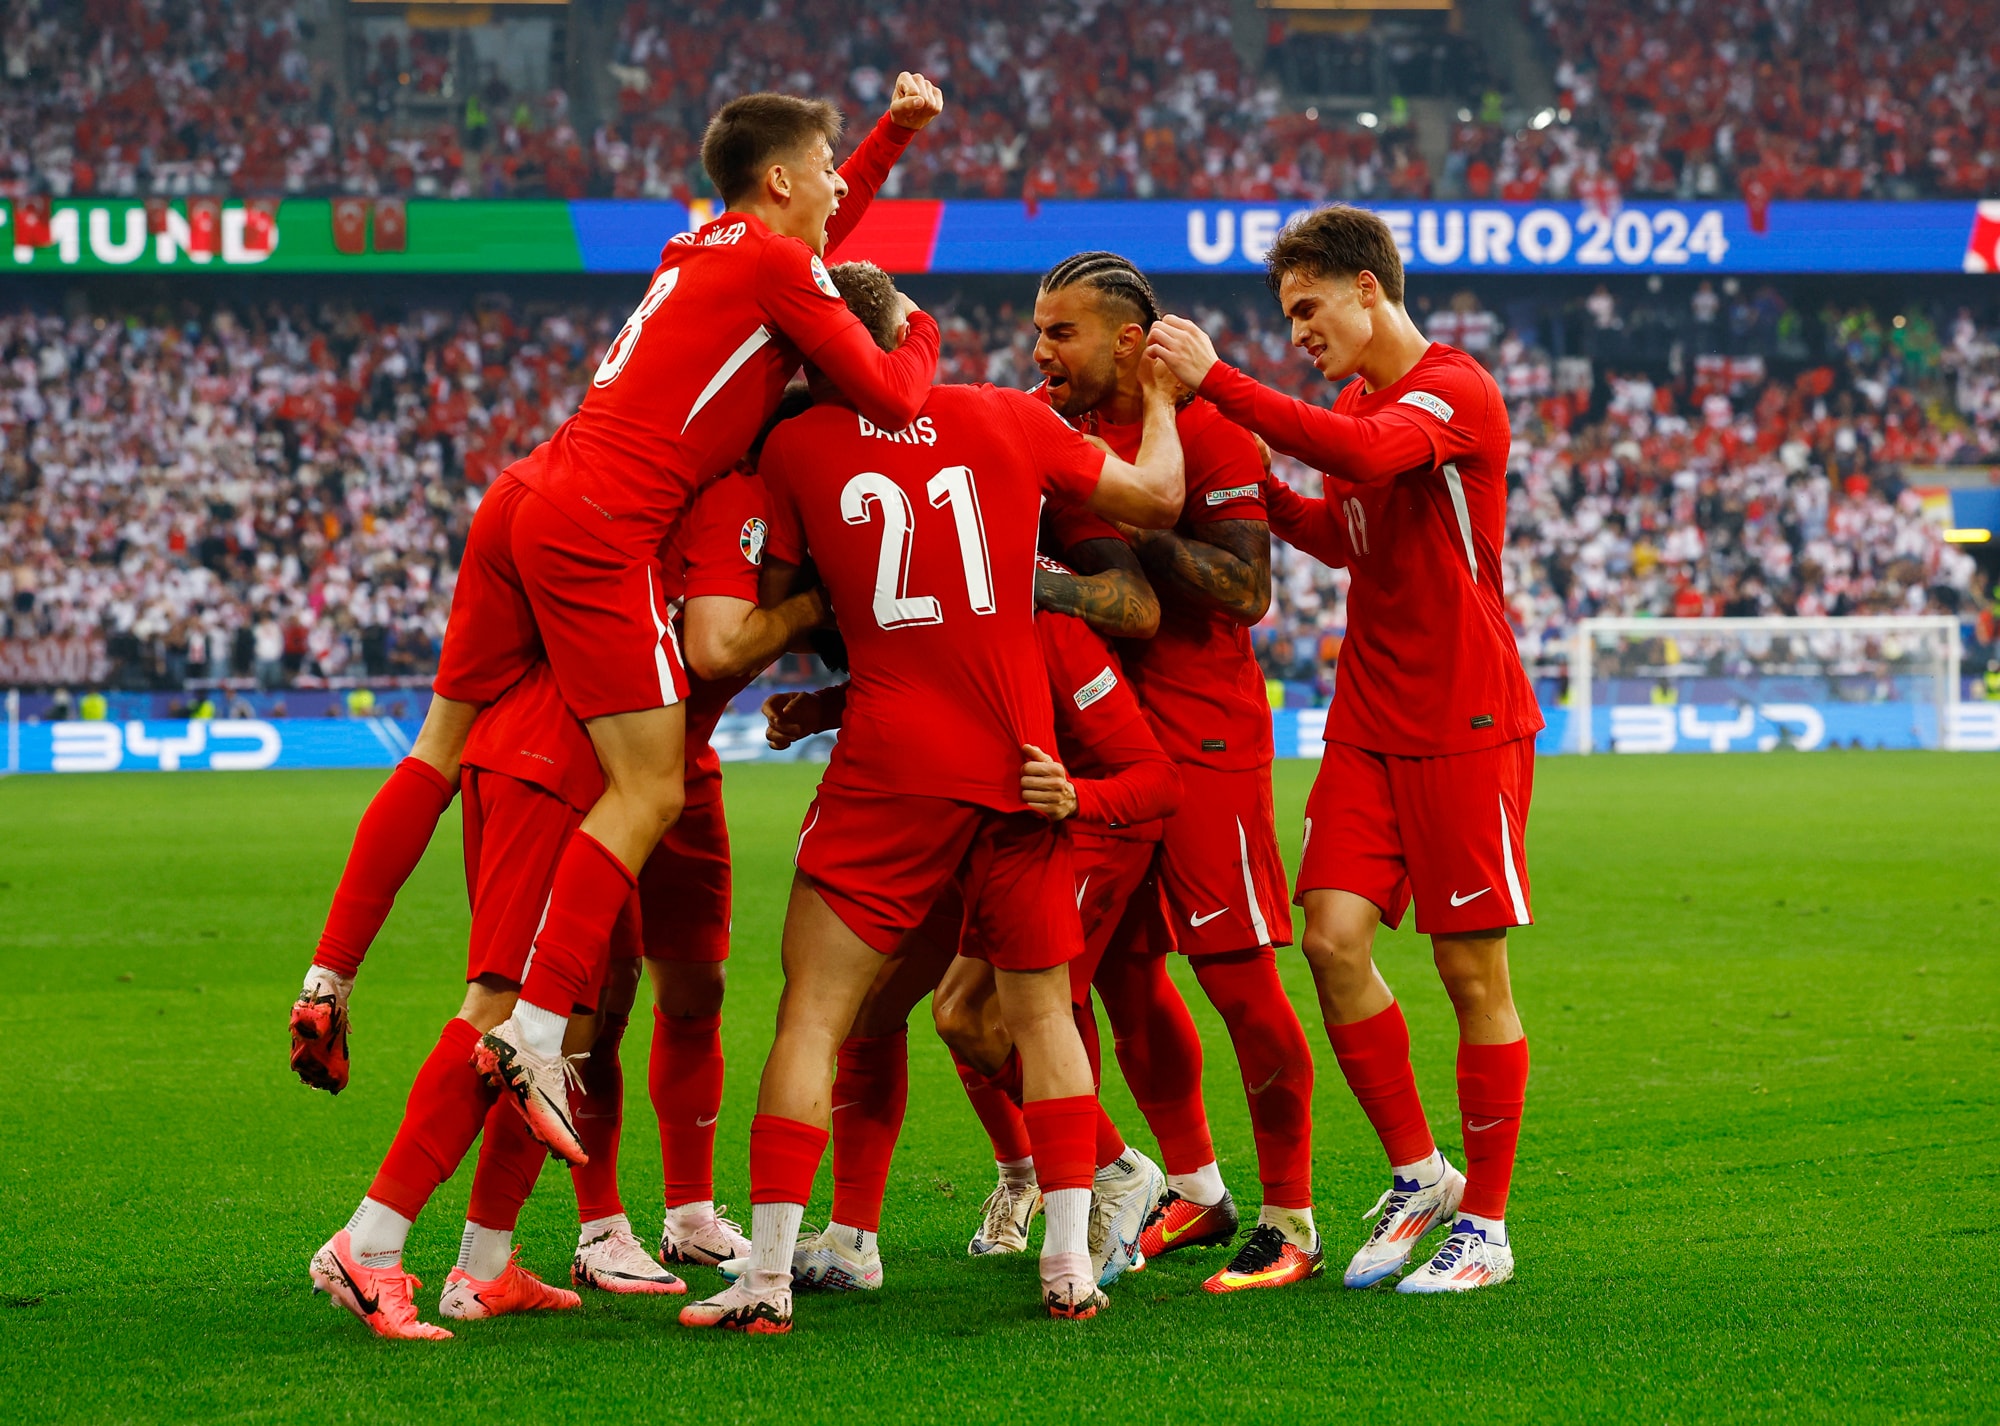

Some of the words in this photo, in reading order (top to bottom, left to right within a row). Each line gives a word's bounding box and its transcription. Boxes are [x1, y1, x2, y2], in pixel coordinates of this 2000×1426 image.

[0, 207, 279, 264] MUND
[1187, 209, 1310, 265] UE
[594, 267, 679, 388] 8
[1207, 489, 1258, 499] FOUNDATION
[840, 465, 996, 631] 21
[1343, 497, 1369, 556] 19
[52, 720, 282, 772] BYD
[1610, 703, 1825, 753] BYD
